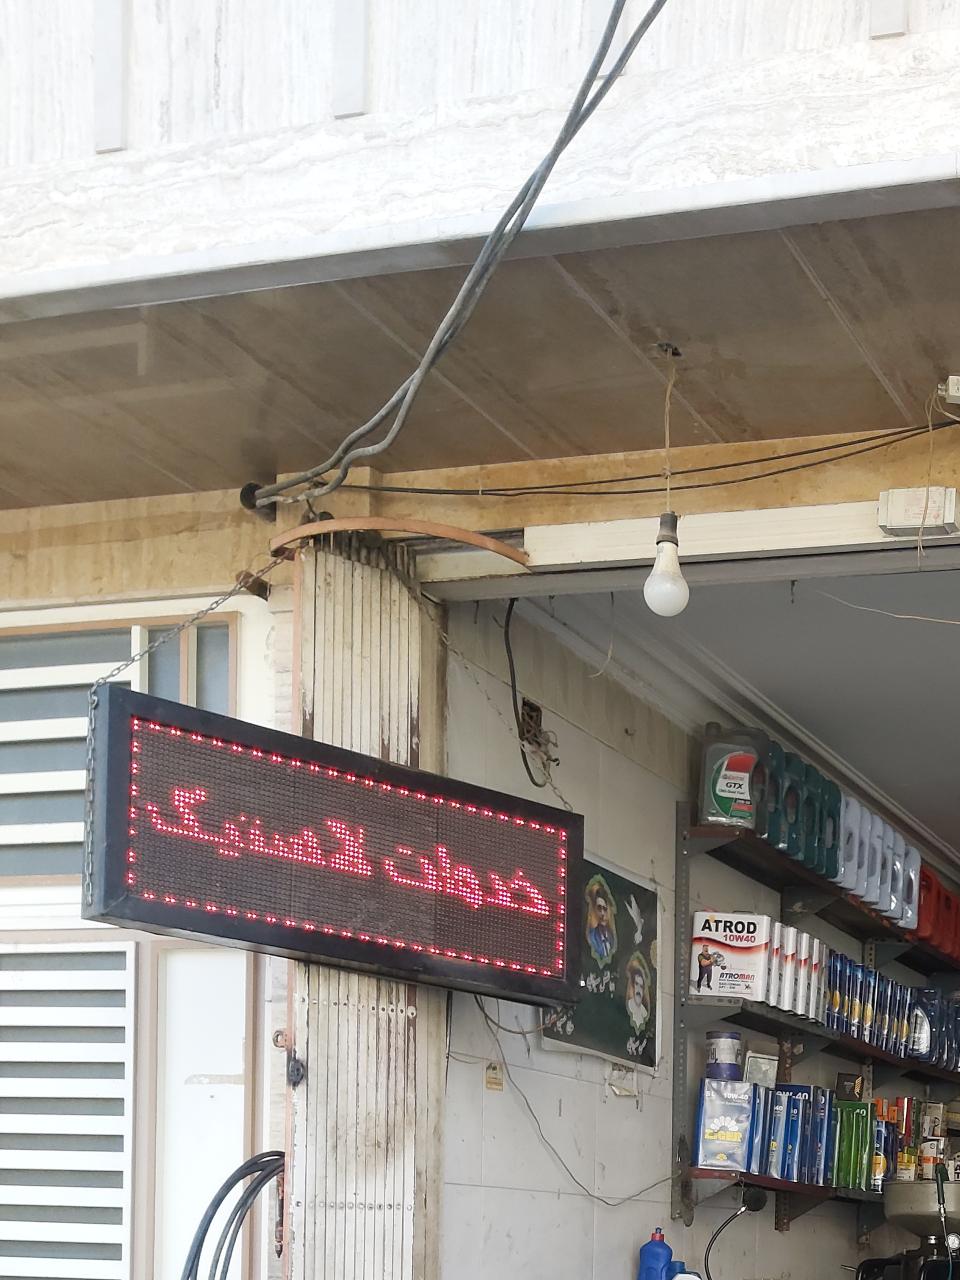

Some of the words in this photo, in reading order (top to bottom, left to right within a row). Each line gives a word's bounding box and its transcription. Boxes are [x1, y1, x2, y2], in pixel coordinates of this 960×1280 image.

[147, 788, 373, 876] لاستیک
[384, 846, 549, 915] خدمات
[701, 919, 757, 934] ATROD
[723, 934, 756, 943] 10W40
